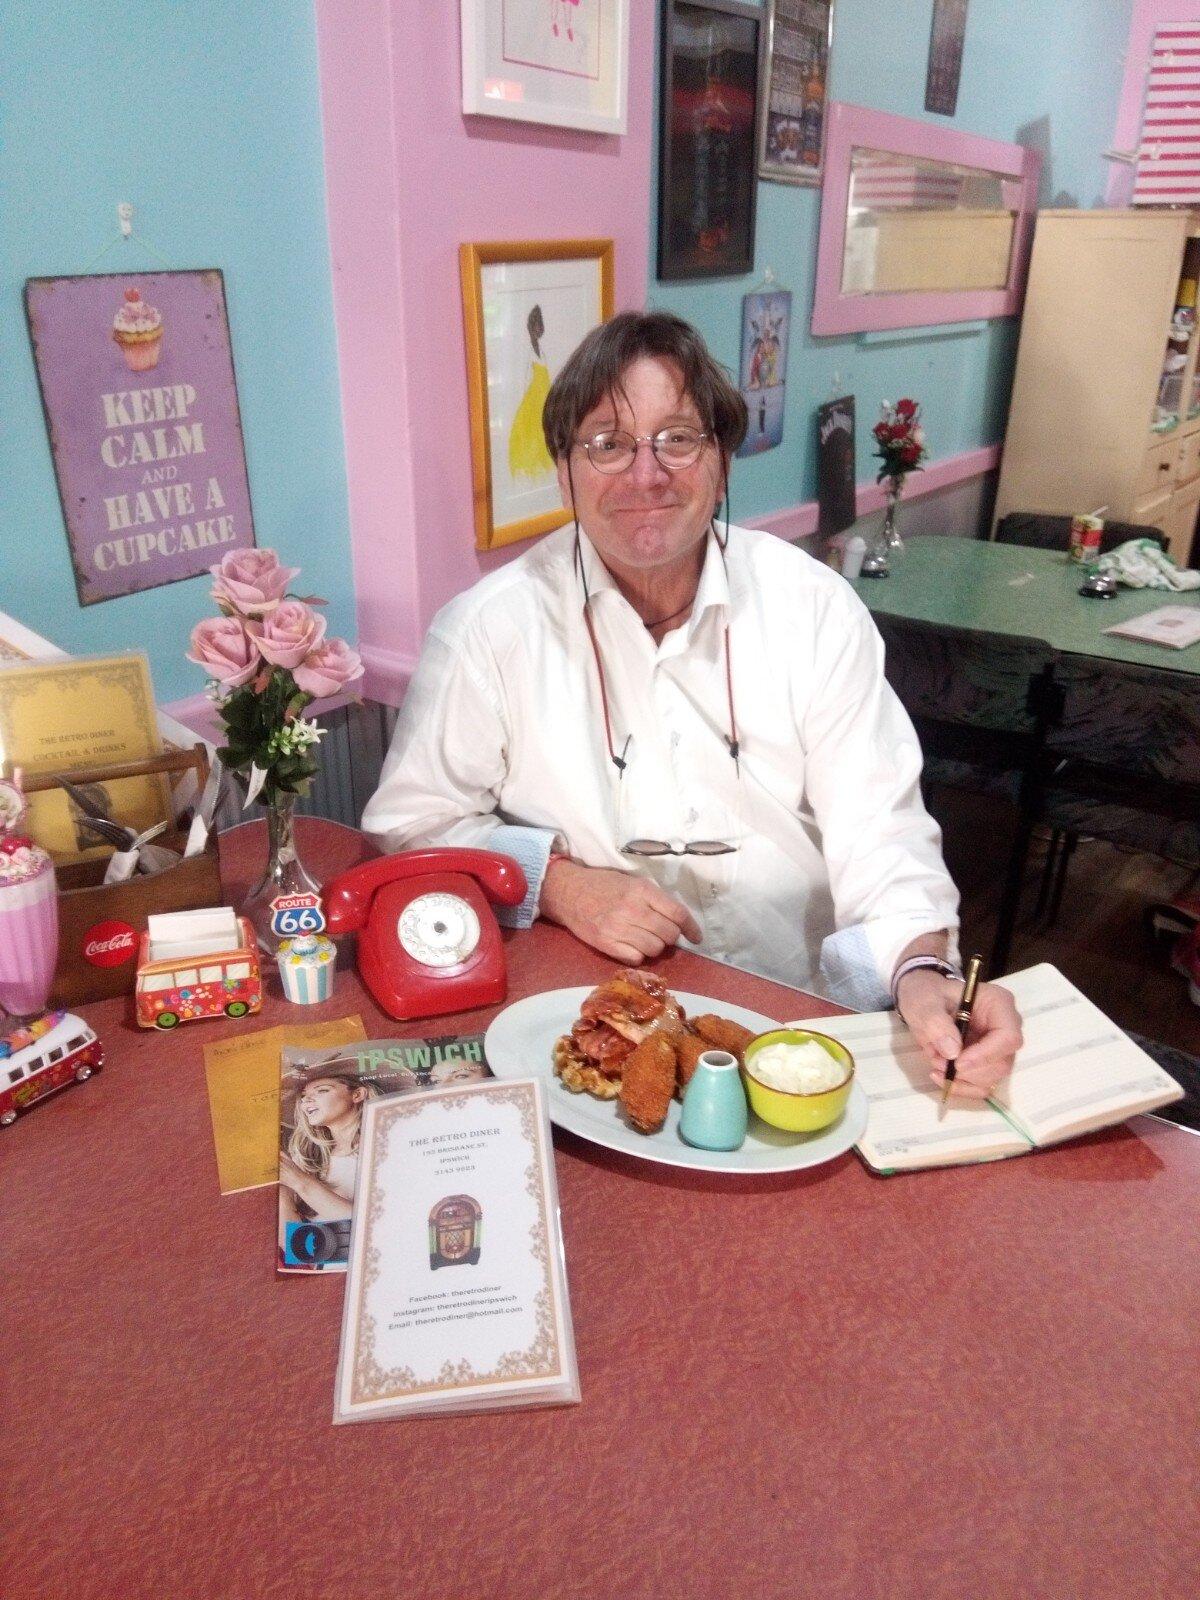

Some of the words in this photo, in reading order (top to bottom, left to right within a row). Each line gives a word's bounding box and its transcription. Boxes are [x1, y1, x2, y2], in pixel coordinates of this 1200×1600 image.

[101, 384, 197, 429] KEEP
[101, 422, 206, 469] CALM
[141, 465, 178, 486] AND
[104, 483, 195, 531] HAVE
[205, 477, 226, 510] A
[93, 515, 237, 572] CUPCAKE
[39, 736, 57, 745] THE
[59, 733, 89, 743] RETRO
[278, 898, 312, 909] ROUTE
[280, 909, 317, 933] 66
[85, 931, 134, 956] Coca-Cola
[356, 1040, 482, 1074] IPSWICH
[408, 1137, 429, 1148] THE
[432, 1132, 467, 1144] RETRO
[469, 1127, 501, 1139] DINER
[409, 1291, 450, 1303] Facebook:
[393, 1306, 435, 1318] Instagram:
[388, 1321, 412, 1331] Email:
